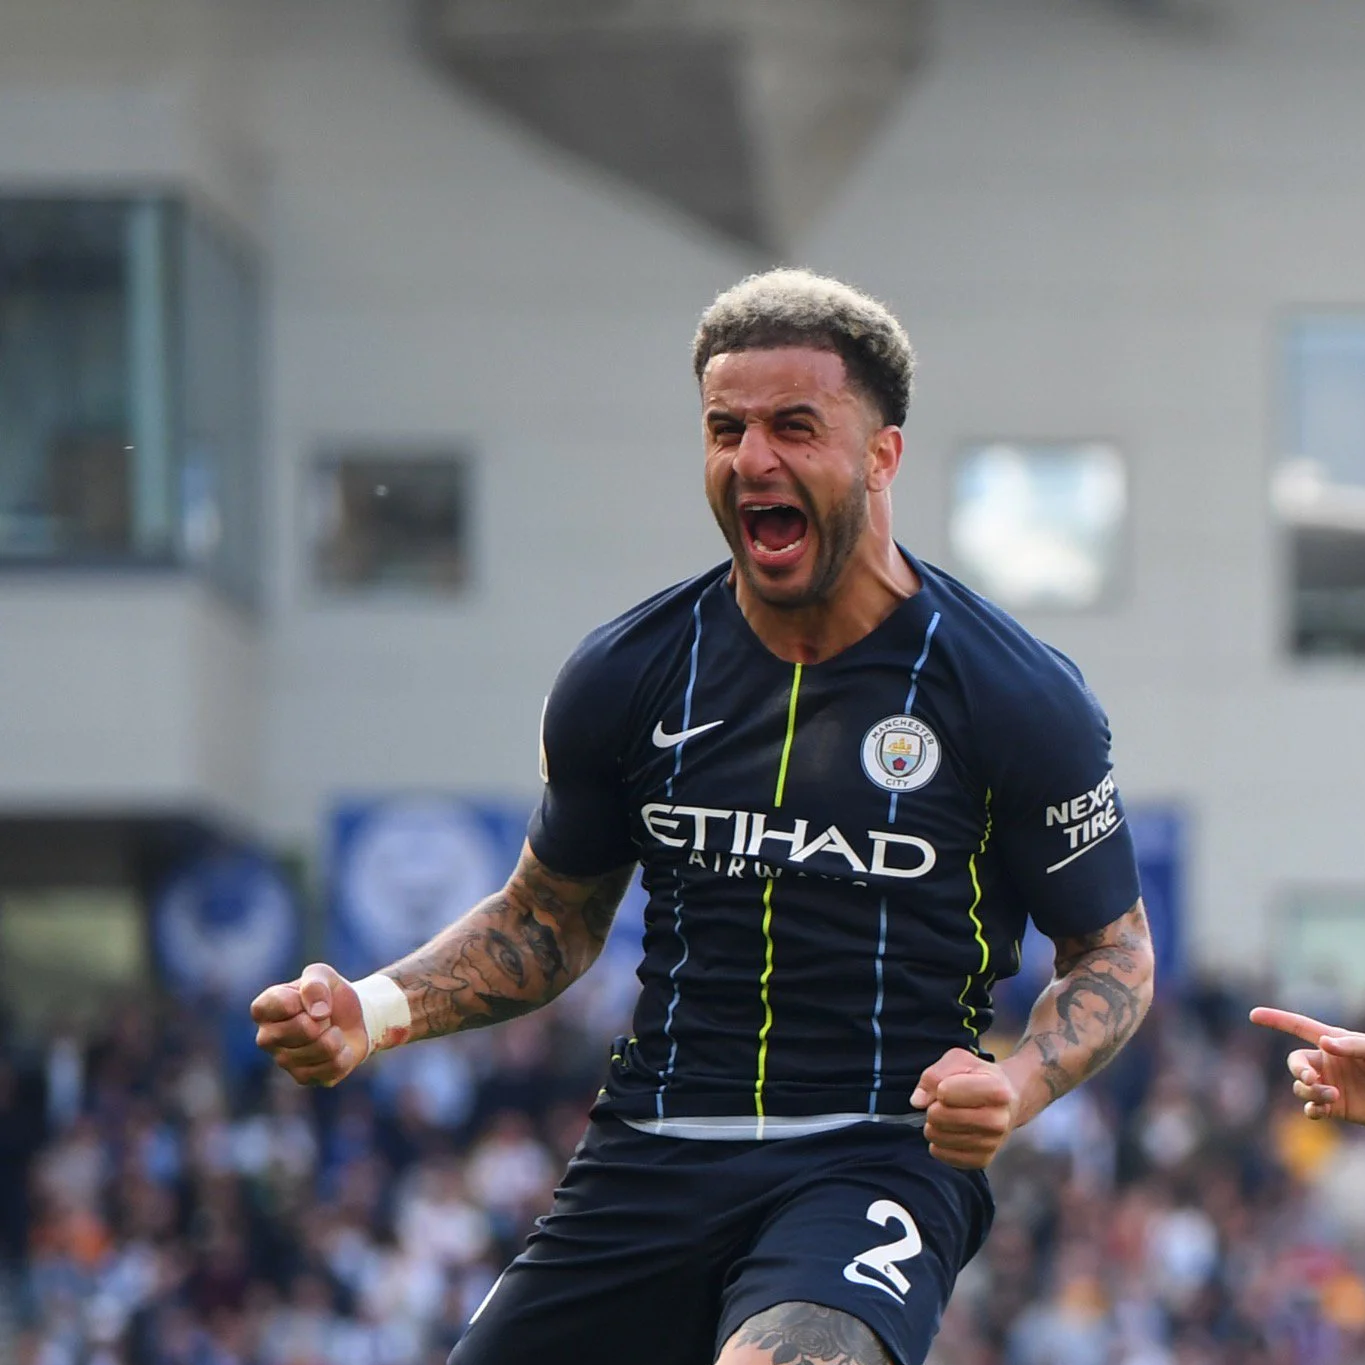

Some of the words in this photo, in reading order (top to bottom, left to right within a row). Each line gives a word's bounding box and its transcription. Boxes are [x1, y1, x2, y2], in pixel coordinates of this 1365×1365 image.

[872, 719, 935, 745] MANCHESTER
[885, 778, 909, 788] CITY
[640, 803, 937, 879] ETIHAD
[1063, 799, 1117, 849] TIRE
[853, 1199, 922, 1295] 2
